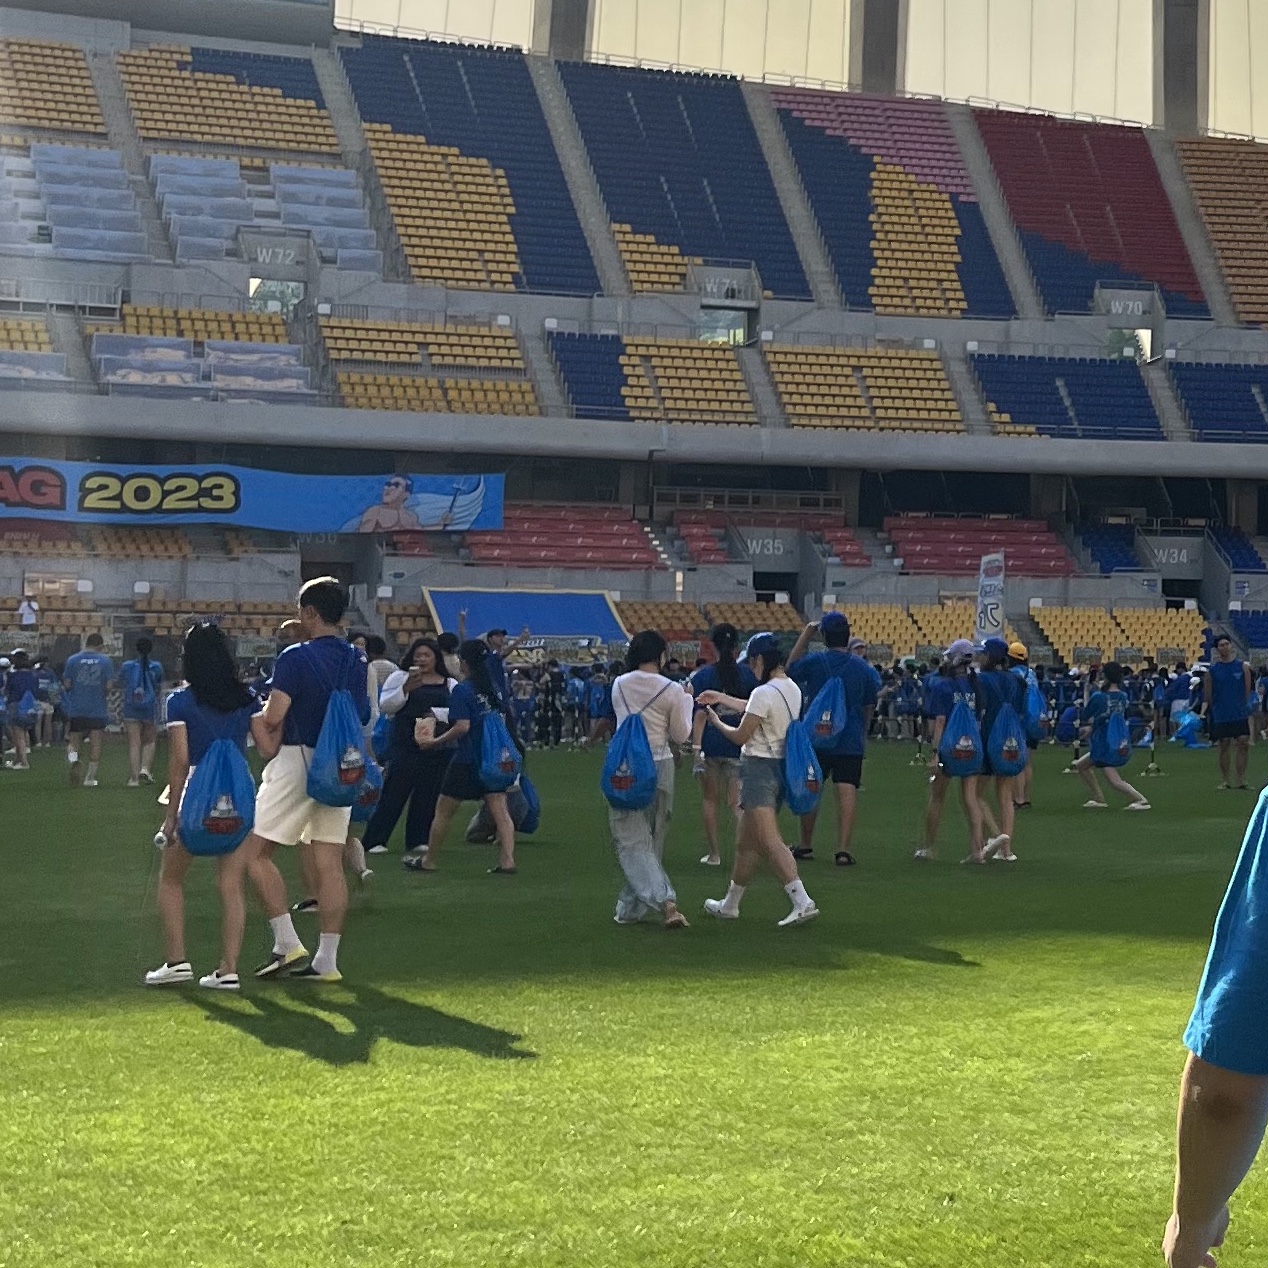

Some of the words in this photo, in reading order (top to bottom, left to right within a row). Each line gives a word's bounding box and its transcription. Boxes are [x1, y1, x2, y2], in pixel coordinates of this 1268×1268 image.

[257, 247, 295, 264] W72
[1111, 300, 1143, 316] W70
[81, 474, 238, 511] 2023
[747, 538, 784, 555] W35
[1154, 548, 1188, 563] W34
